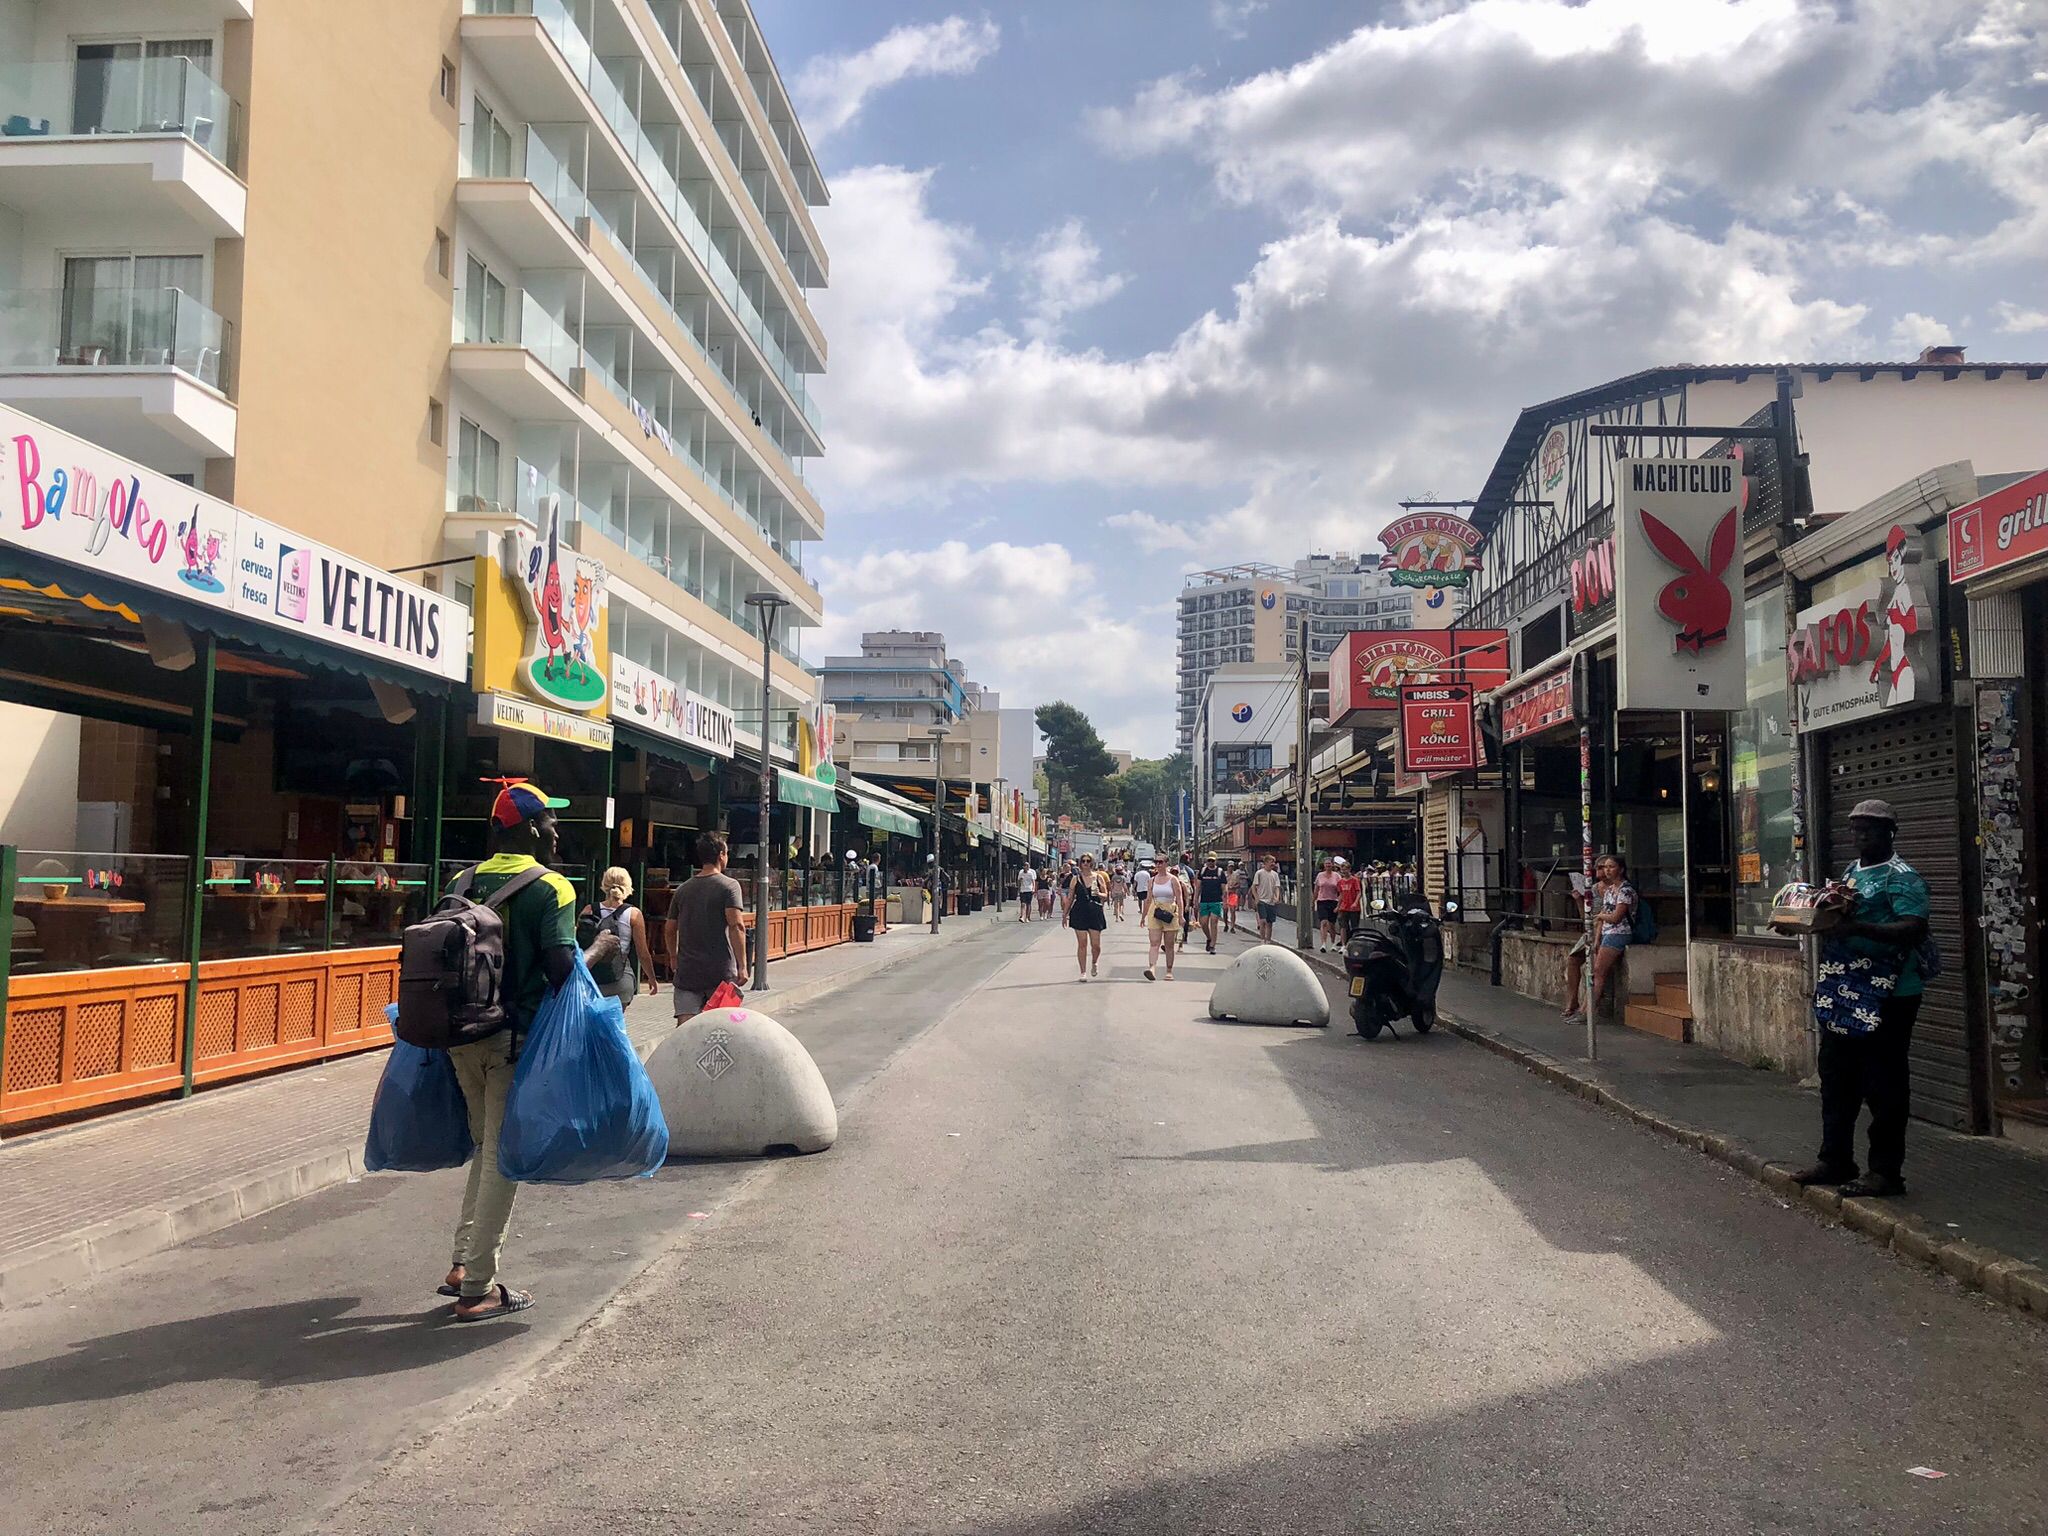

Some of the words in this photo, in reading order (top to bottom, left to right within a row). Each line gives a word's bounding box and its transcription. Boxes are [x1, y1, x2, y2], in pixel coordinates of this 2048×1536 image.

[1633, 464, 1731, 493] NACHTCLUB
[12, 434, 167, 564] Bamboleo
[254, 531, 264, 549] La
[1383, 516, 1480, 546] BIERKÖNIG
[241, 558, 273, 580] cerveza
[242, 582, 268, 605] fresca
[283, 580, 306, 599] VELTINS
[320, 558, 440, 660] VELTINS
[1788, 600, 1871, 685] SAFOS
[1413, 691, 1450, 700] IMBISS
[1813, 706, 1830, 719] GUTE
[1831, 691, 1880, 714] ATMOSPHÄRE
[497, 703, 524, 725] VELTINS
[1421, 708, 1456, 718] GRILL
[589, 727, 611, 745] VELTINS
[696, 702, 733, 749] VELTINS
[1420, 734, 1460, 745] KÖNIG
